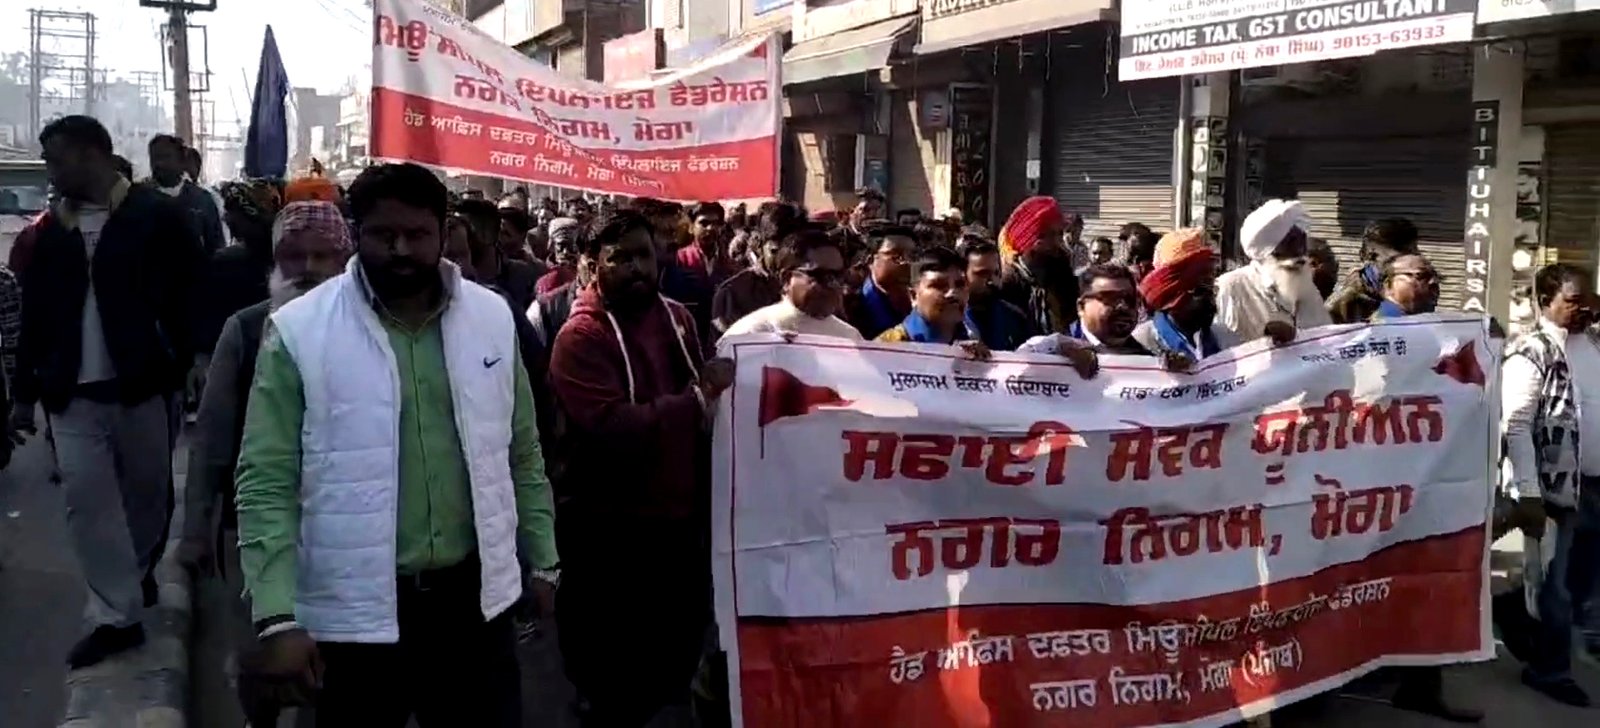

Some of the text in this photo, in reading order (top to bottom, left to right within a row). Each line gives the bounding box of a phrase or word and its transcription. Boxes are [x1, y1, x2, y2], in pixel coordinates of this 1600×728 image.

[1132, 28, 1197, 54] INCOME
[1249, 15, 1288, 37] GST
[1295, 0, 1446, 32] CONSULTANT
[1333, 25, 1445, 50] 98153-63933
[1105, 419, 1231, 482] ਸੇਵਕ
[1251, 389, 1444, 485] ਯੂਨੀਅਨ
[885, 515, 1061, 580] ਨਗਰ
[1311, 473, 1414, 540] ਮੋਗਾ
[1029, 679, 1098, 712] ਨਗਰ
